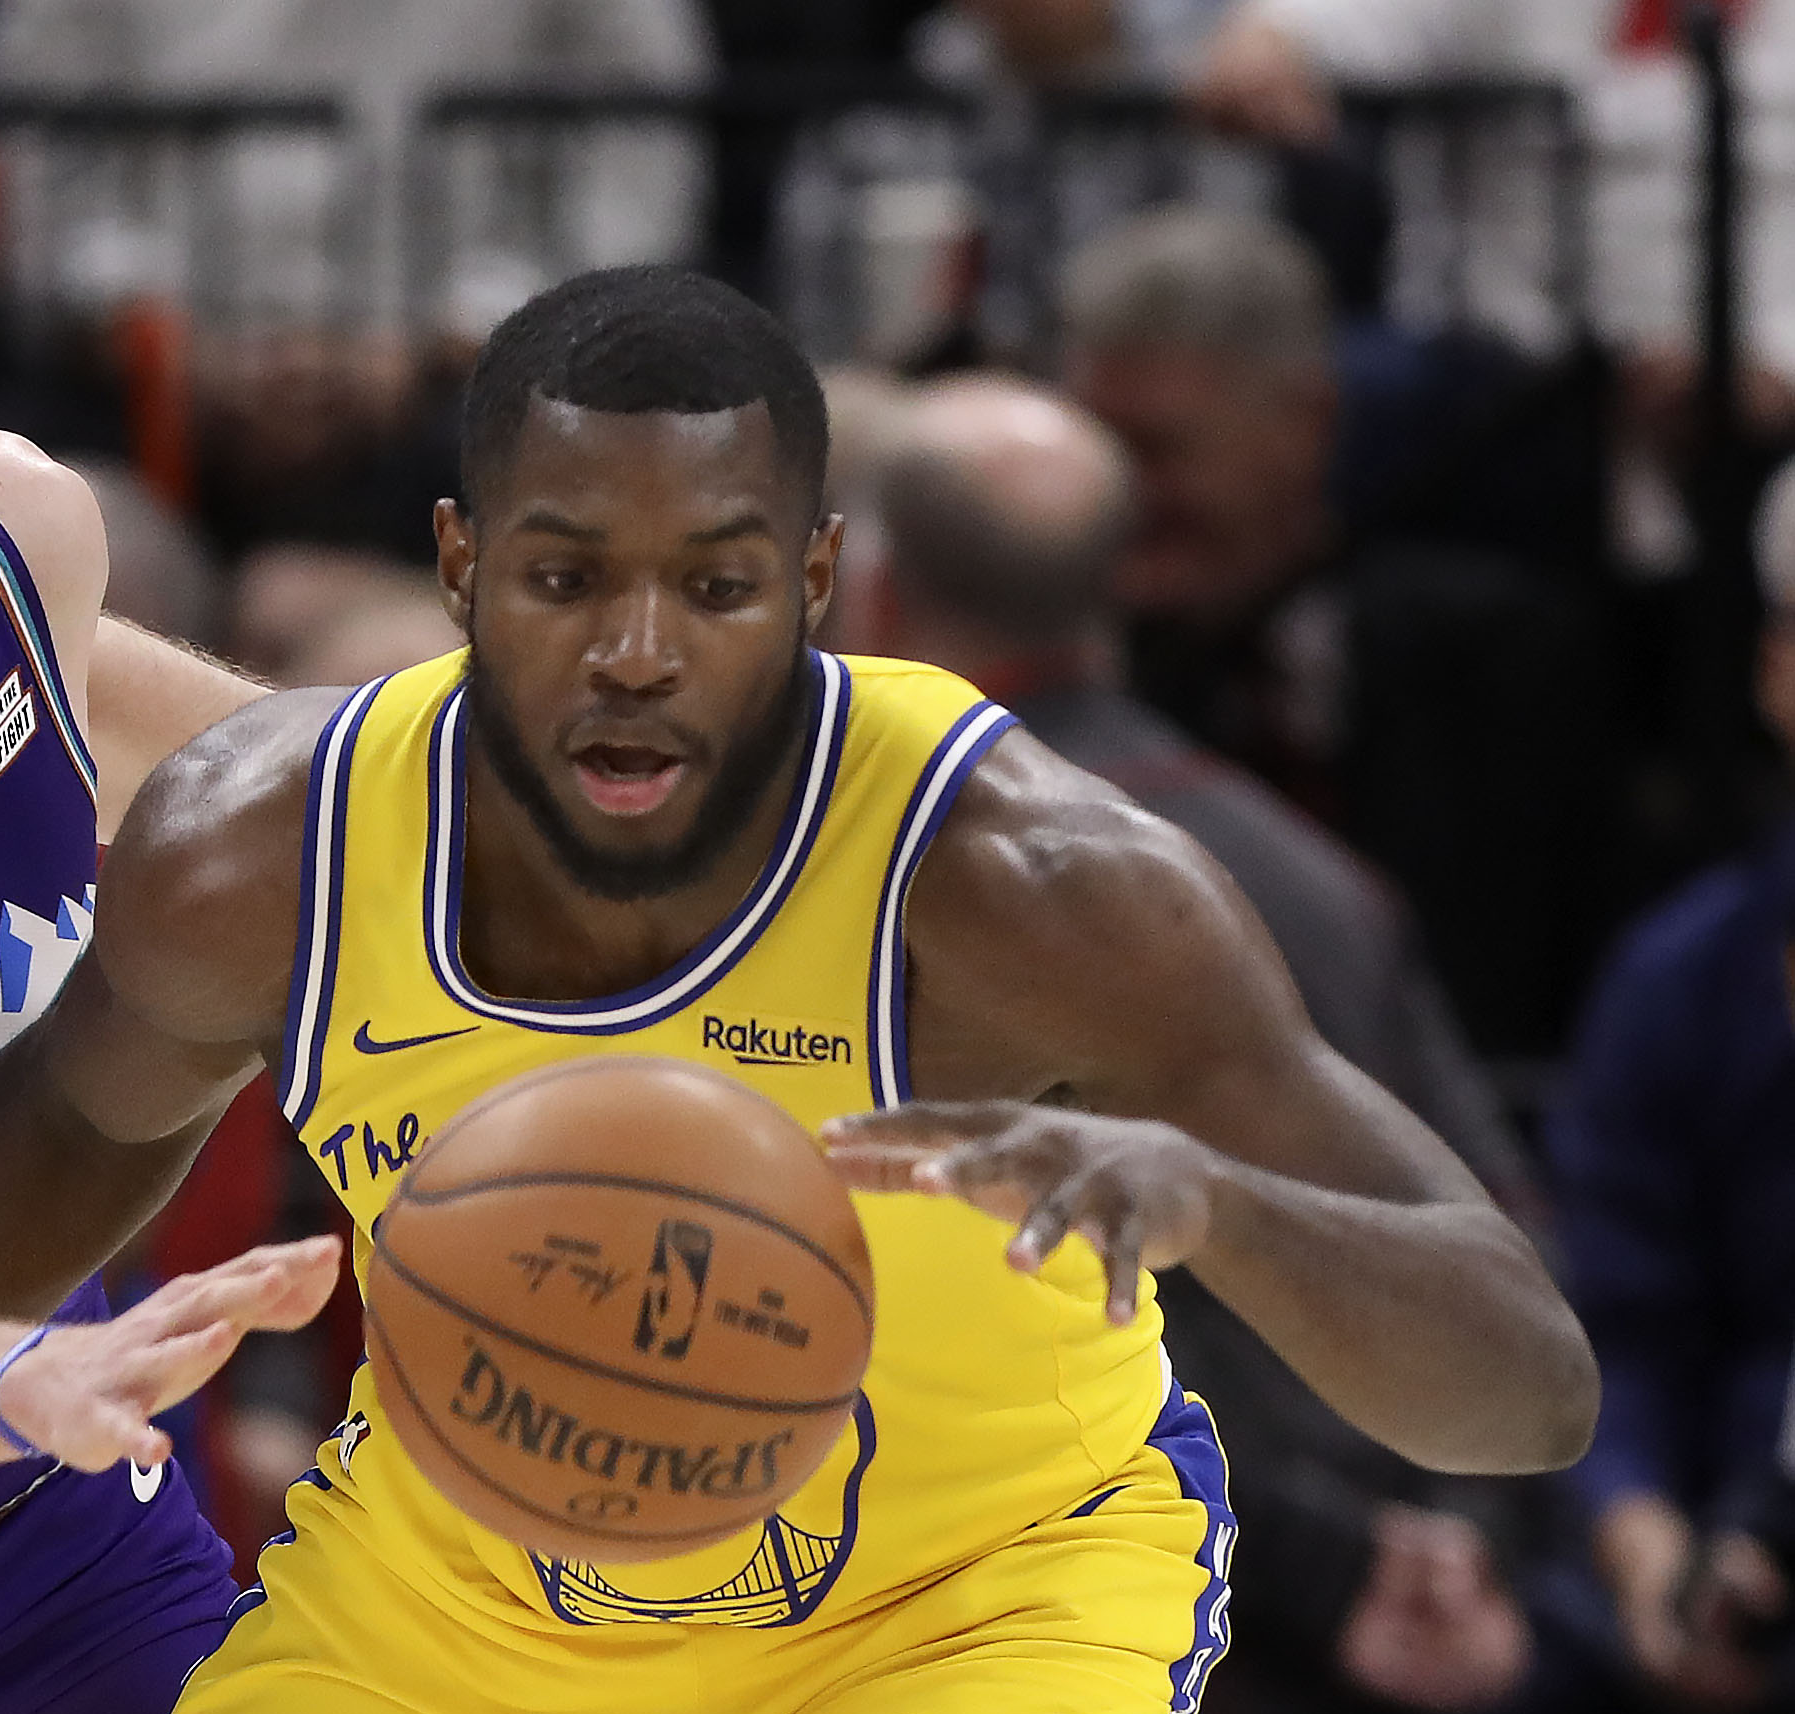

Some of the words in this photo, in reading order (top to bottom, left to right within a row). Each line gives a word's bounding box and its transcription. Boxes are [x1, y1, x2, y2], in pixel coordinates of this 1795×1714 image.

[702, 1013, 852, 1065] Rakuten
[319, 1112, 427, 1191] The
[449, 1347, 795, 1496] SPALDING
